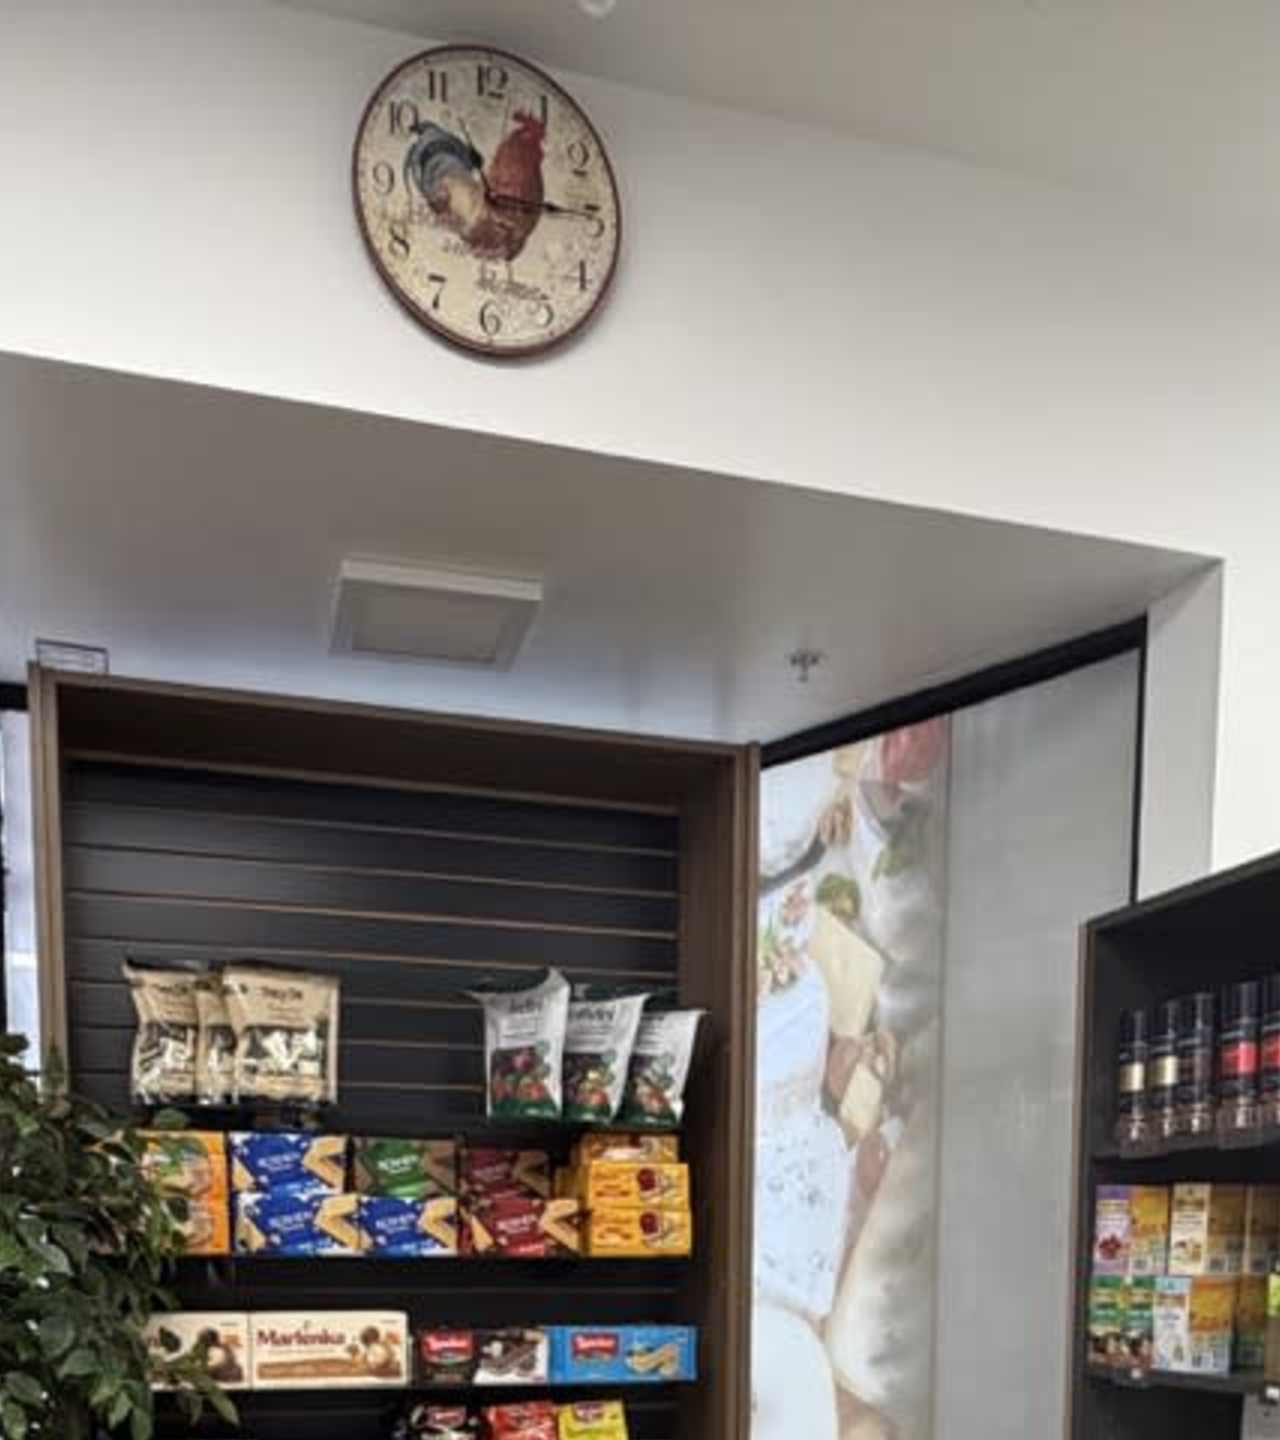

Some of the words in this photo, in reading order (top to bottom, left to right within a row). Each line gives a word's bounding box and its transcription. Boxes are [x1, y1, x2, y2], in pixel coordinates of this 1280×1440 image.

[428, 70, 447, 102] 11
[477, 64, 509, 98] 12
[390, 101, 419, 134] 10
[568, 143, 590, 177] 2
[373, 162, 395, 194] 9
[388, 221, 410, 257] 8
[428, 274, 446, 309] 7
[479, 301, 501, 335] 6
